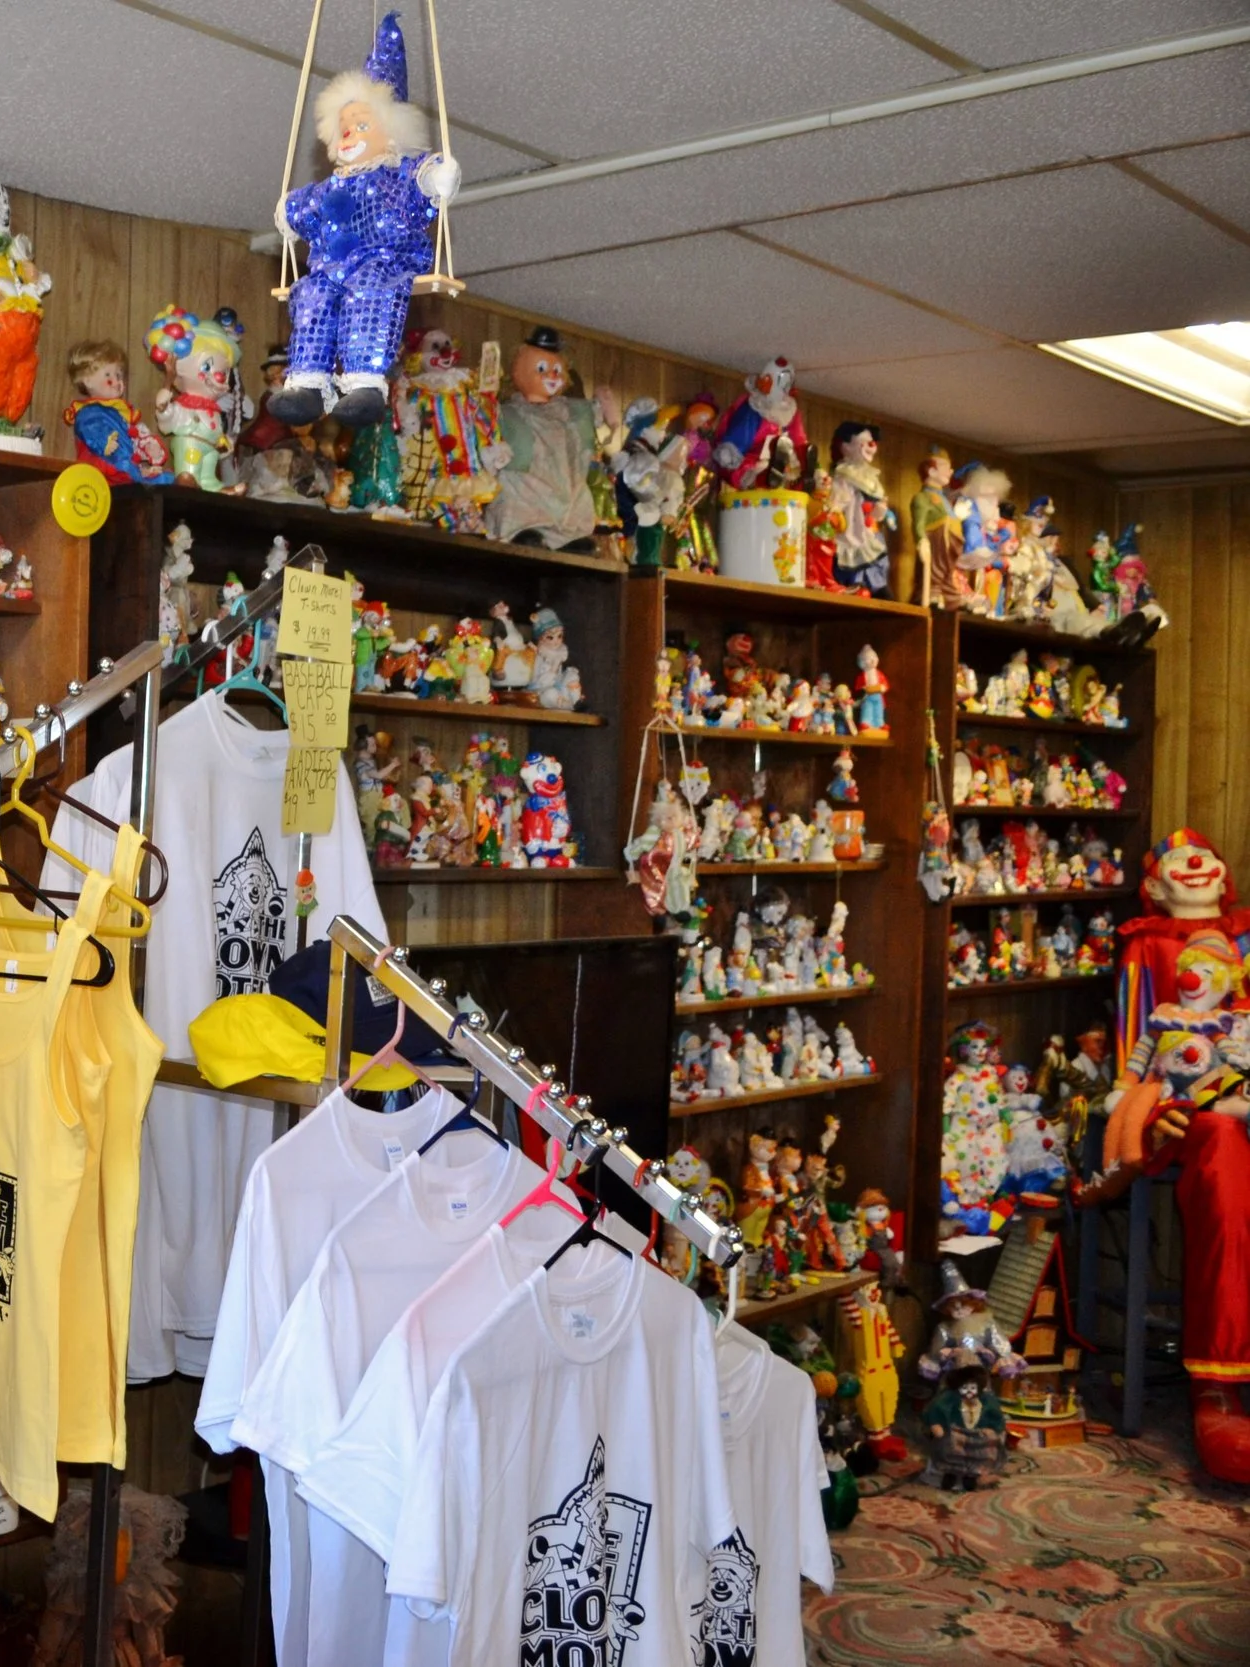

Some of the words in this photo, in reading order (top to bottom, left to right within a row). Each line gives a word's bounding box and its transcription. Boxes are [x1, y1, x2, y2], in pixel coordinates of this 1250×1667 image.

[288, 575, 317, 594] Clown
[285, 662, 348, 689] BASEBALL
[297, 685, 334, 711] CAPS
[292, 749, 333, 771] LADIES
[285, 767, 311, 790] TANK
[312, 768, 337, 790] TOPS
[215, 934, 285, 974] OWN
